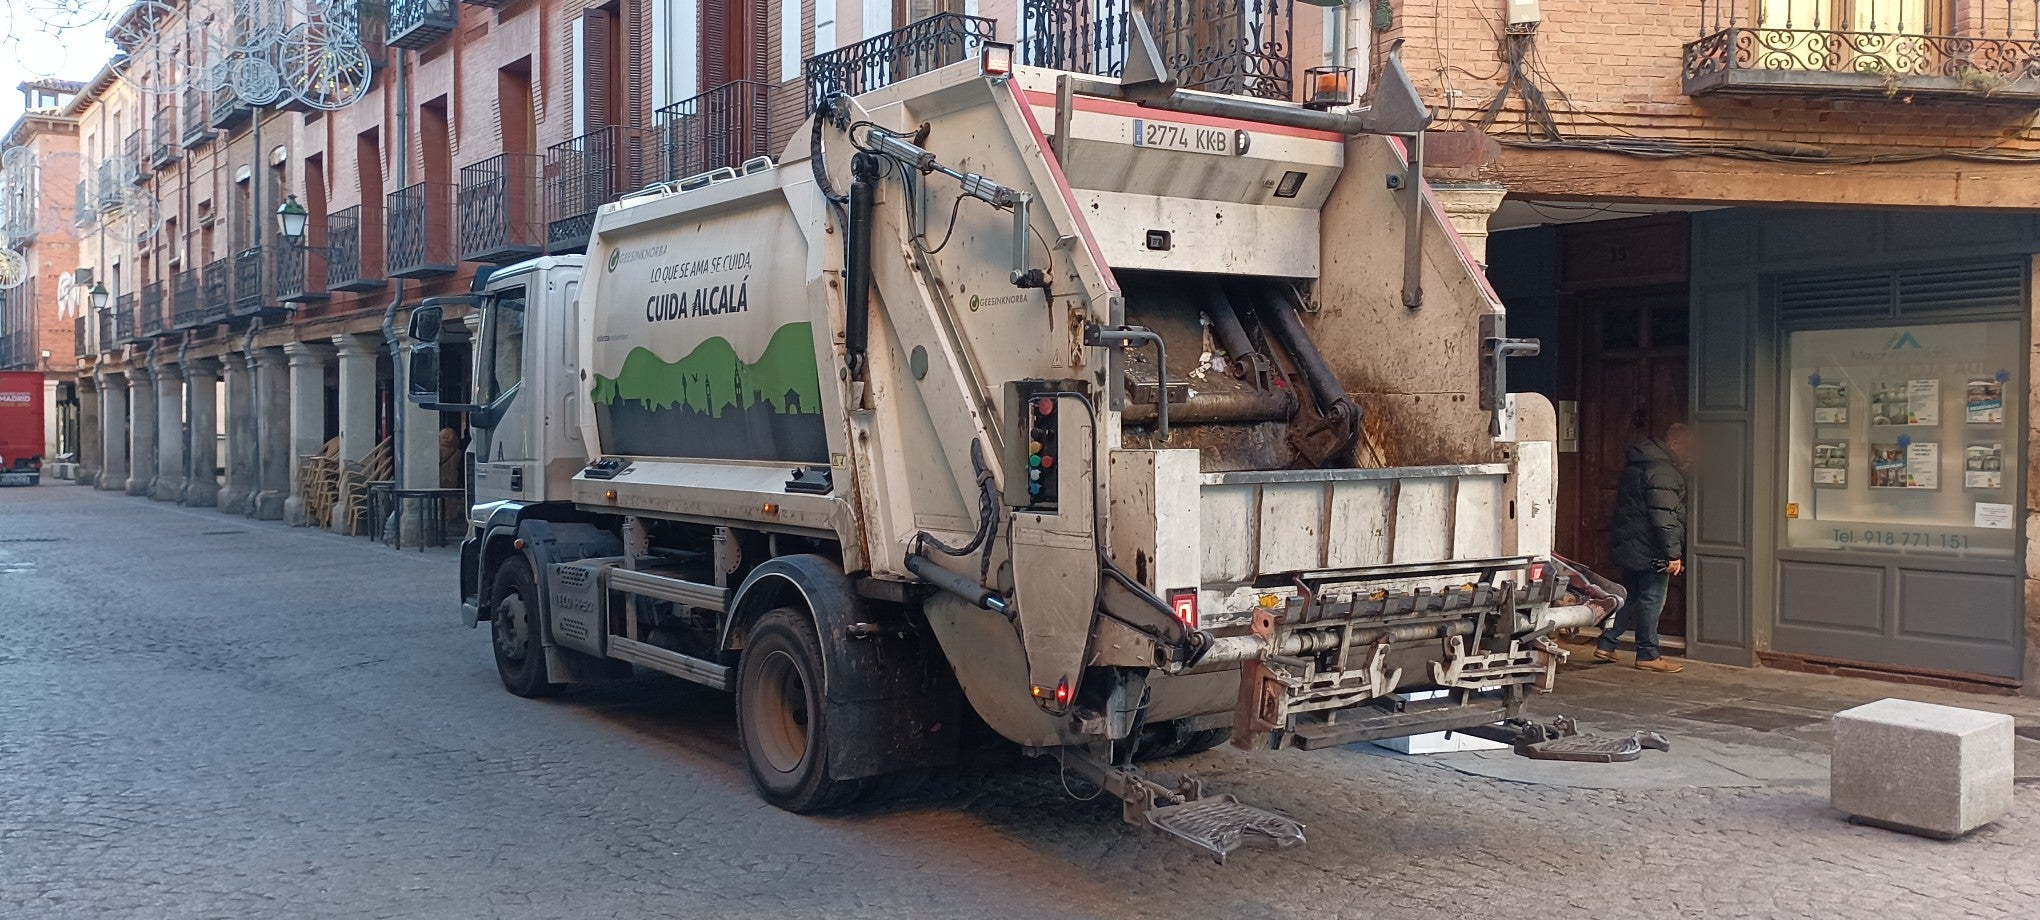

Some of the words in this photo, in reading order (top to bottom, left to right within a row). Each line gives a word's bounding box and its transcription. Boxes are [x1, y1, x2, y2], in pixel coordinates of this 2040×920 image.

[1147, 124, 1188, 148] 2774
[1196, 128, 1226, 152] KKB
[619, 245, 668, 264] GEESINKNORBA
[650, 267, 661, 283] LO
[662, 264, 680, 284] QUE
[680, 262, 691, 279] SE
[690, 259, 709, 278] AMA
[711, 256, 722, 274] SE
[723, 251, 752, 272] CUIDA,
[646, 291, 688, 323] CUIDA
[692, 274, 748, 318] ALCALÁ
[980, 294, 1028, 307] GEESINKNORBA
[1833, 529, 1858, 543] Tel.
[1864, 530, 1895, 546] 918
[1901, 532, 1930, 547] 771
[1940, 534, 1969, 550] 151
